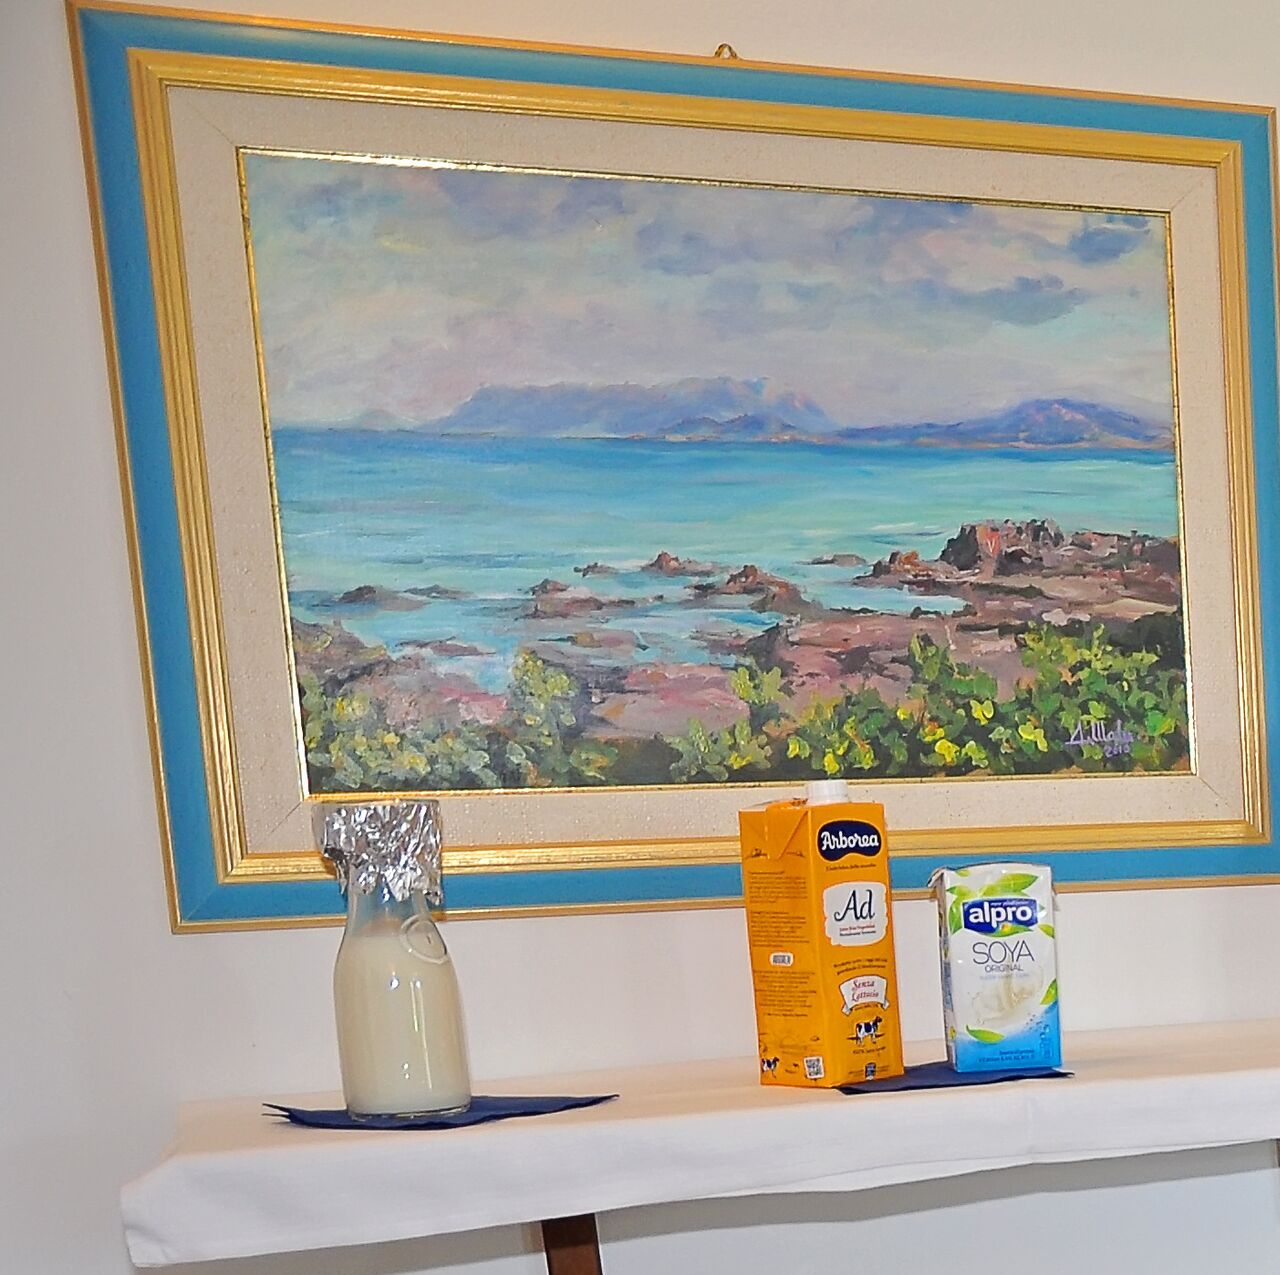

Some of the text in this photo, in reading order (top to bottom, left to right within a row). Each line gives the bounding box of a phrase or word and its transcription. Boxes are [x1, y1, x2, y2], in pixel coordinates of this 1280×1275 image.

[820, 830, 880, 851] Arborea
[834, 889, 875, 922] Ad
[968, 901, 1033, 928] alpro
[972, 940, 1035, 964] SOYA
[984, 963, 1024, 973] ORIGINAL
